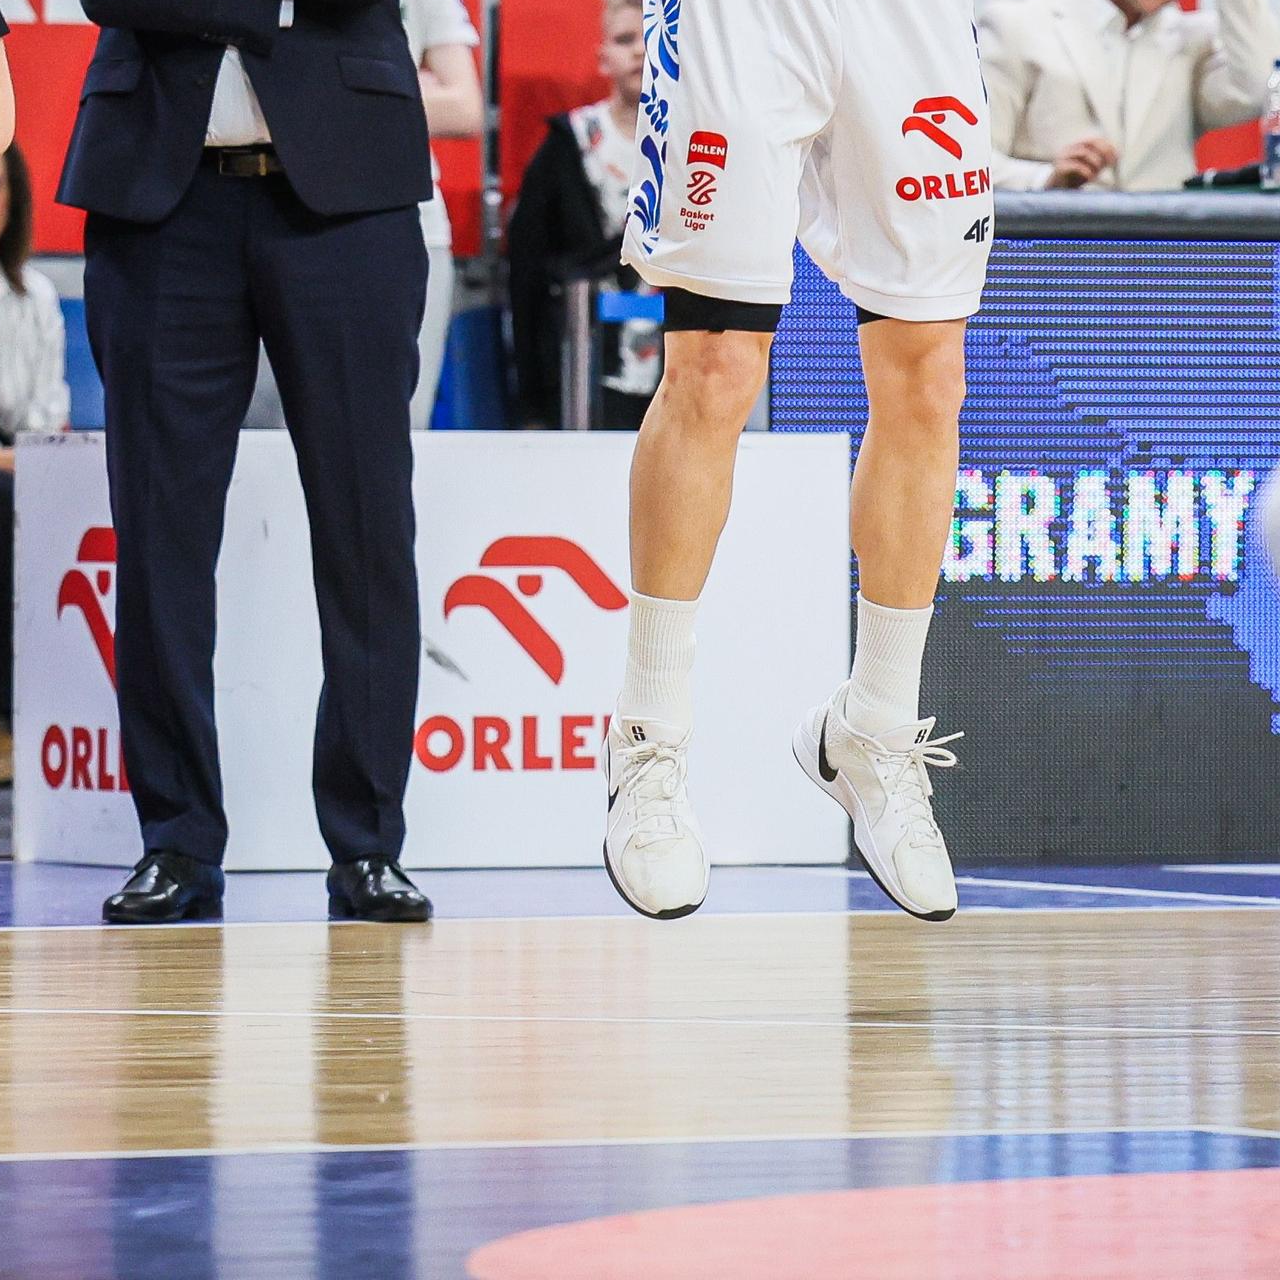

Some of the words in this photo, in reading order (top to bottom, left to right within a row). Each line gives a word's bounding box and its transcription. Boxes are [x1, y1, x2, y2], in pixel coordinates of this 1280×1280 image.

[690, 143, 726, 157] ORLEN
[895, 166, 990, 202] ORLEN
[680, 207, 715, 222] Basket
[684, 218, 706, 232] Liga
[939, 470, 1257, 582] GRAMY
[41, 724, 132, 792] ORL
[415, 714, 612, 772] ORLE
